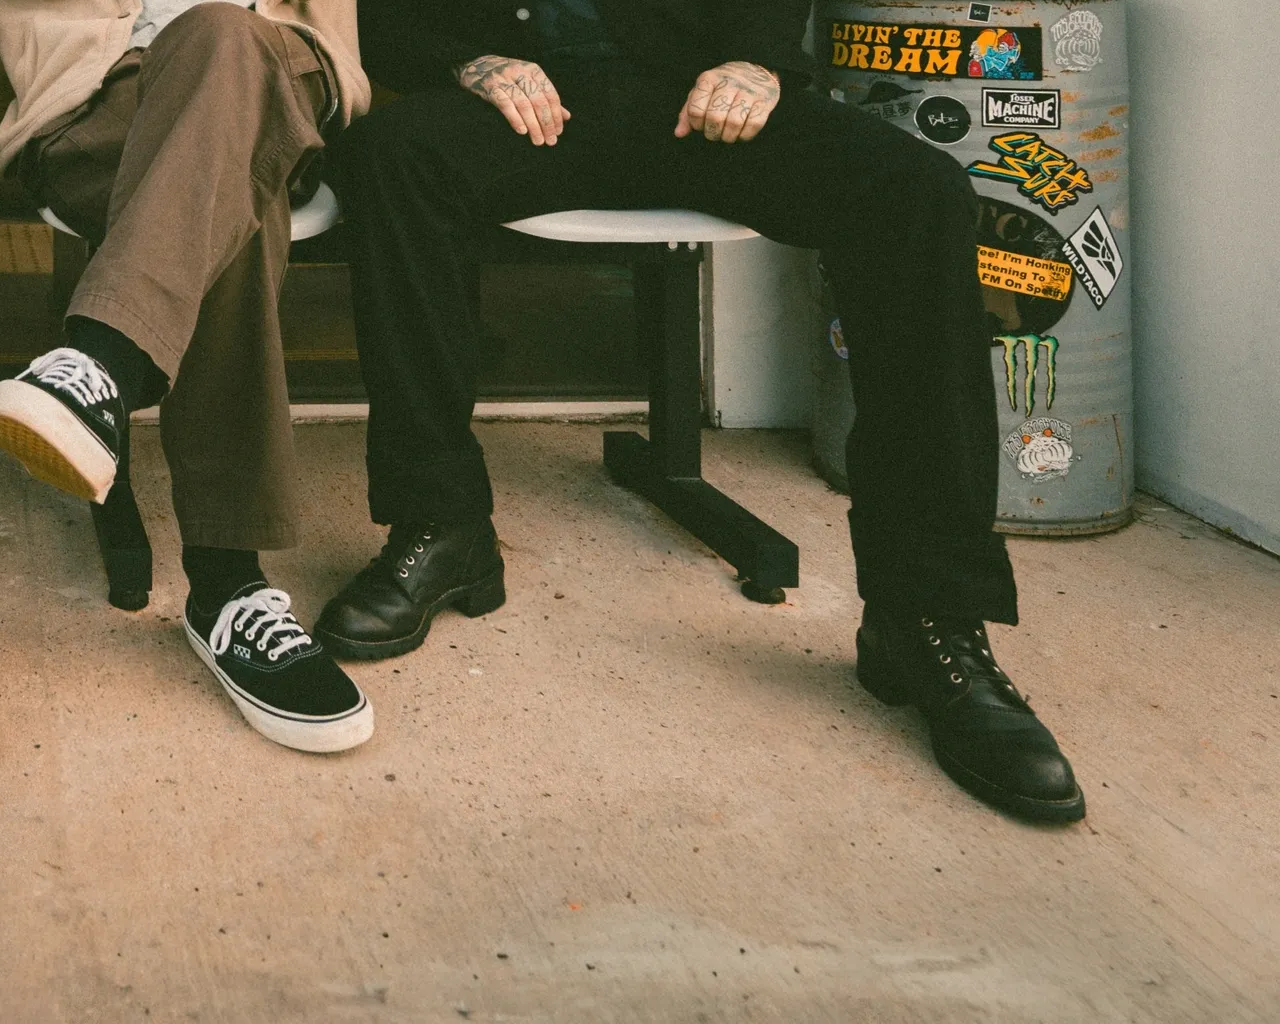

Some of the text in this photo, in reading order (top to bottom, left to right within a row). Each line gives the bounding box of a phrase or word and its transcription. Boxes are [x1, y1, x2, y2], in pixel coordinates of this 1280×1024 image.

[903, 28, 962, 48] THE
[831, 42, 962, 75] DREAM
[988, 96, 1055, 124] MACHINE
[1003, 116, 1040, 124] COMPANY
[993, 133, 1092, 189] CATCH
[974, 156, 1076, 207] SURF
[979, 249, 1071, 276] ee! I'm Honking
[979, 262, 1046, 282] stening To
[981, 272, 1001, 284] FM
[1005, 278, 1022, 289] On
